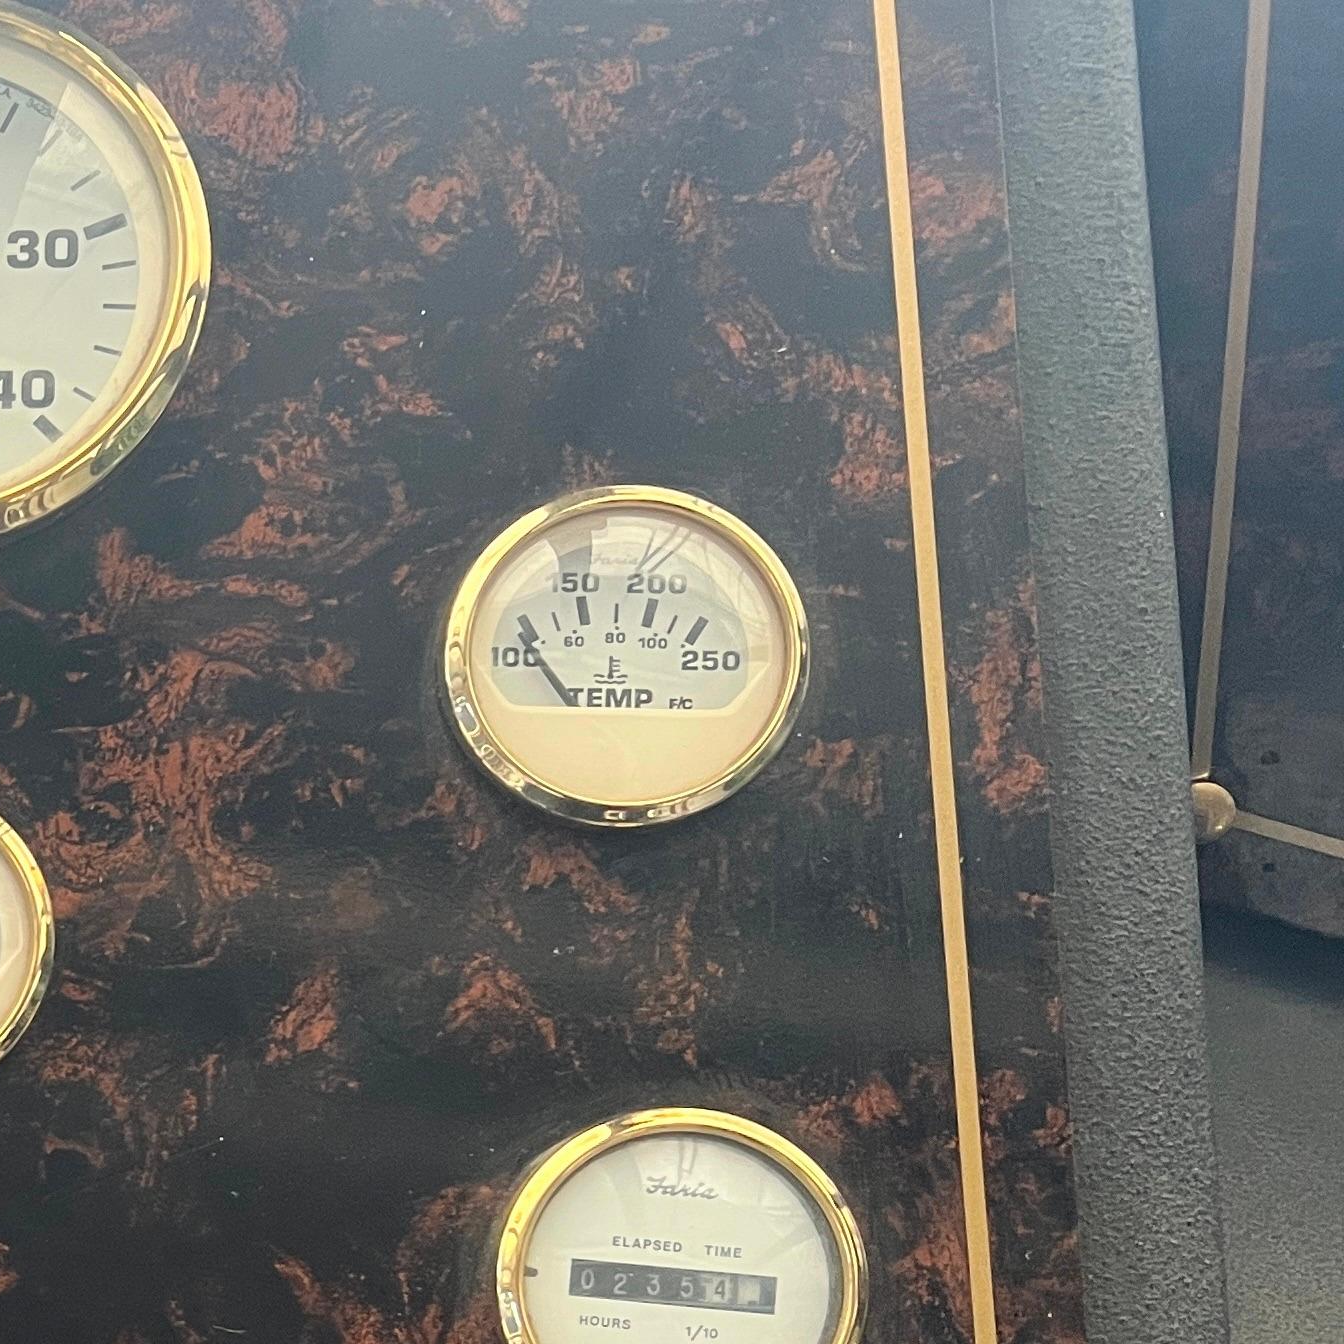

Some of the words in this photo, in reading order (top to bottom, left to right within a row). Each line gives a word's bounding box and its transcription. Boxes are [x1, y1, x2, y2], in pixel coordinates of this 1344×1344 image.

[7, 228, 79, 269] 30
[626, 573, 687, 594] 200
[564, 636, 584, 648] 60
[605, 632, 626, 644] 80
[638, 637, 668, 650] 100
[491, 646, 541, 667] 100
[681, 651, 740, 671] 250
[566, 688, 653, 708] TEMP
[668, 697, 693, 709] F/C
[646, 1177, 719, 1199] Faria
[612, 1236, 682, 1252] ELAPSED
[704, 1245, 742, 1258] TIME
[580, 1316, 631, 1329] HOURS
[685, 1326, 718, 1341] 1/10
